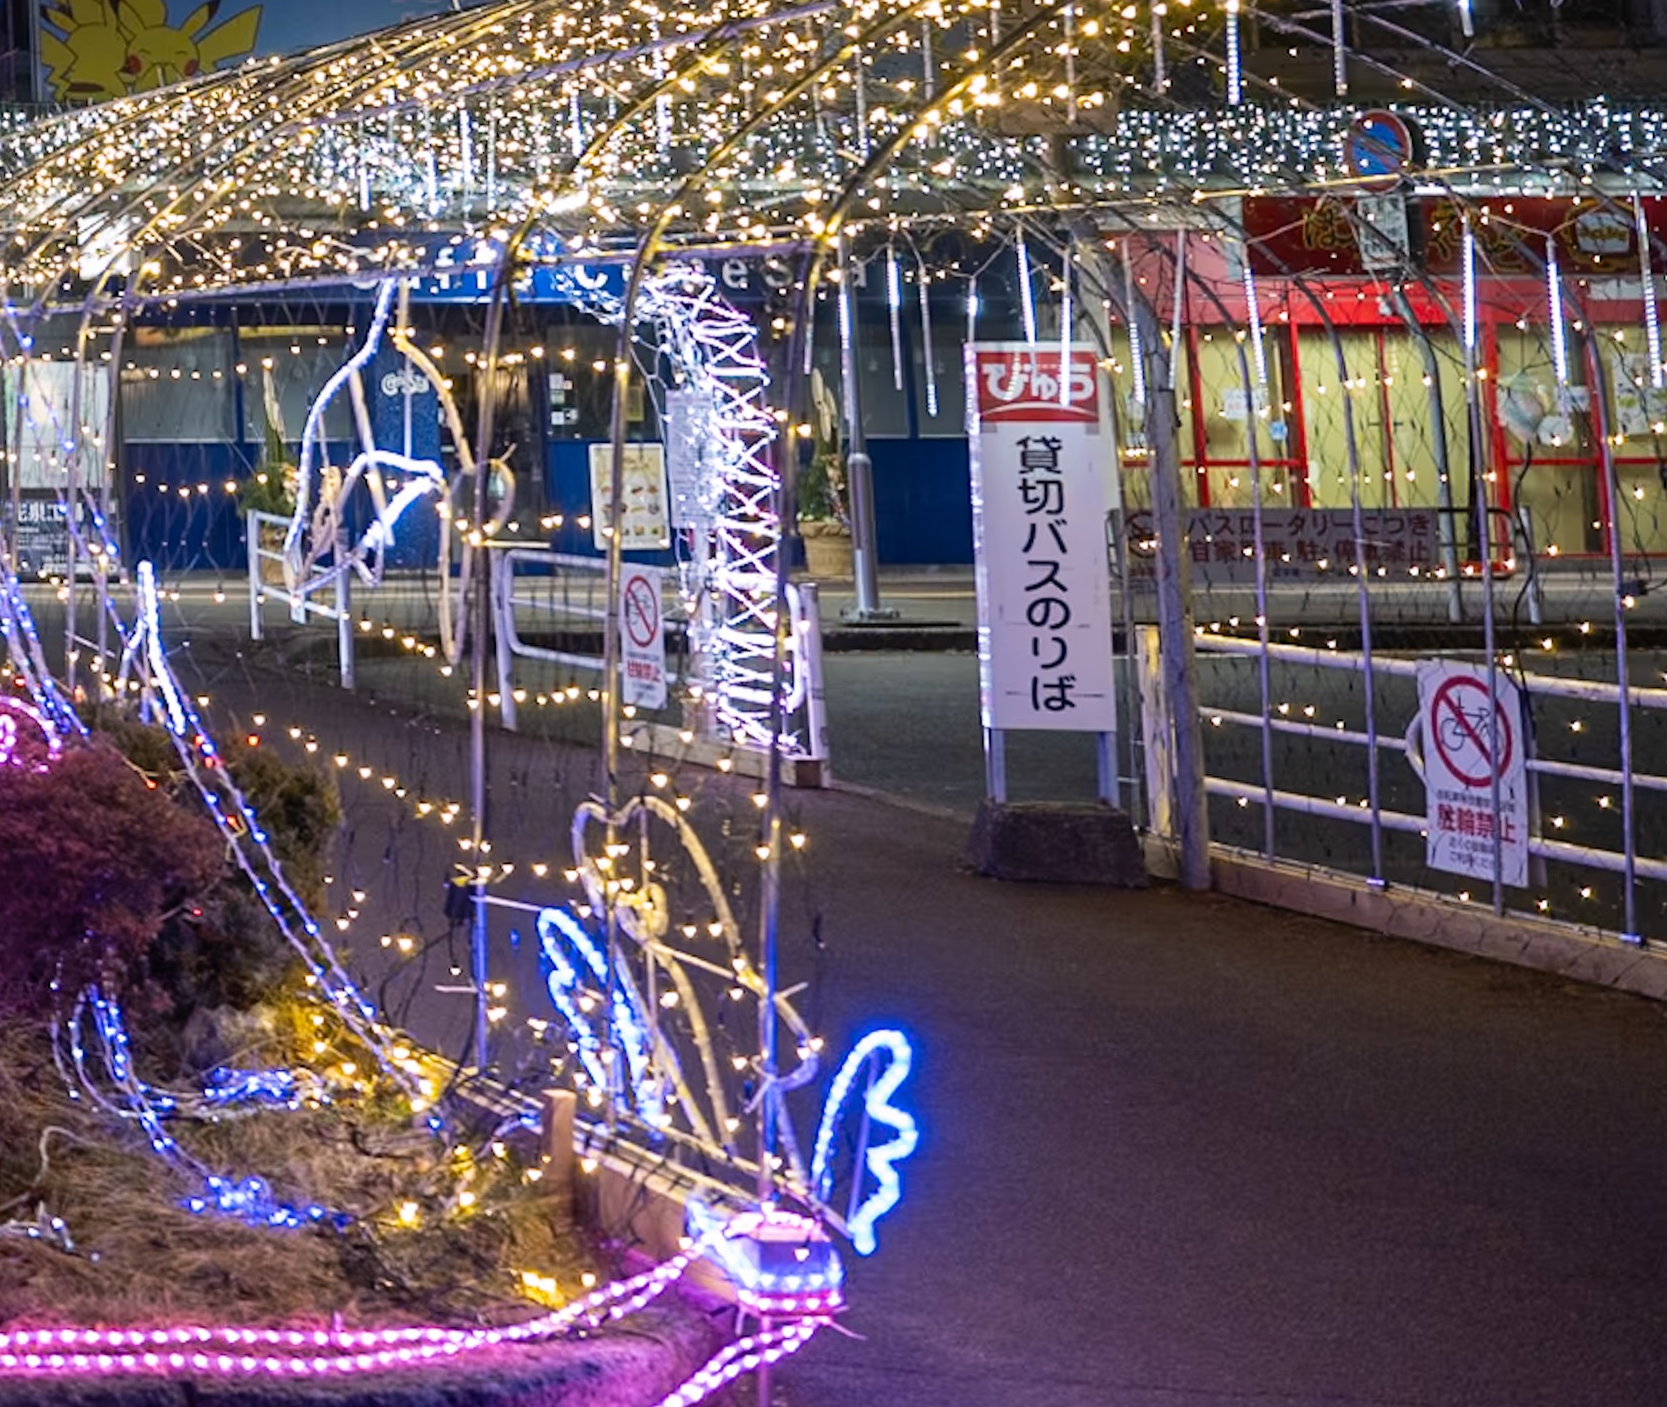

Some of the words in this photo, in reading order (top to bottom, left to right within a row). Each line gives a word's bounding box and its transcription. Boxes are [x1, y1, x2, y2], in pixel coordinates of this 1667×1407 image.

[981, 362, 1095, 402] びゅう
[1015, 435, 1077, 713] 貸切バスのりば
[1437, 802, 1517, 844] 駐輪禁止
